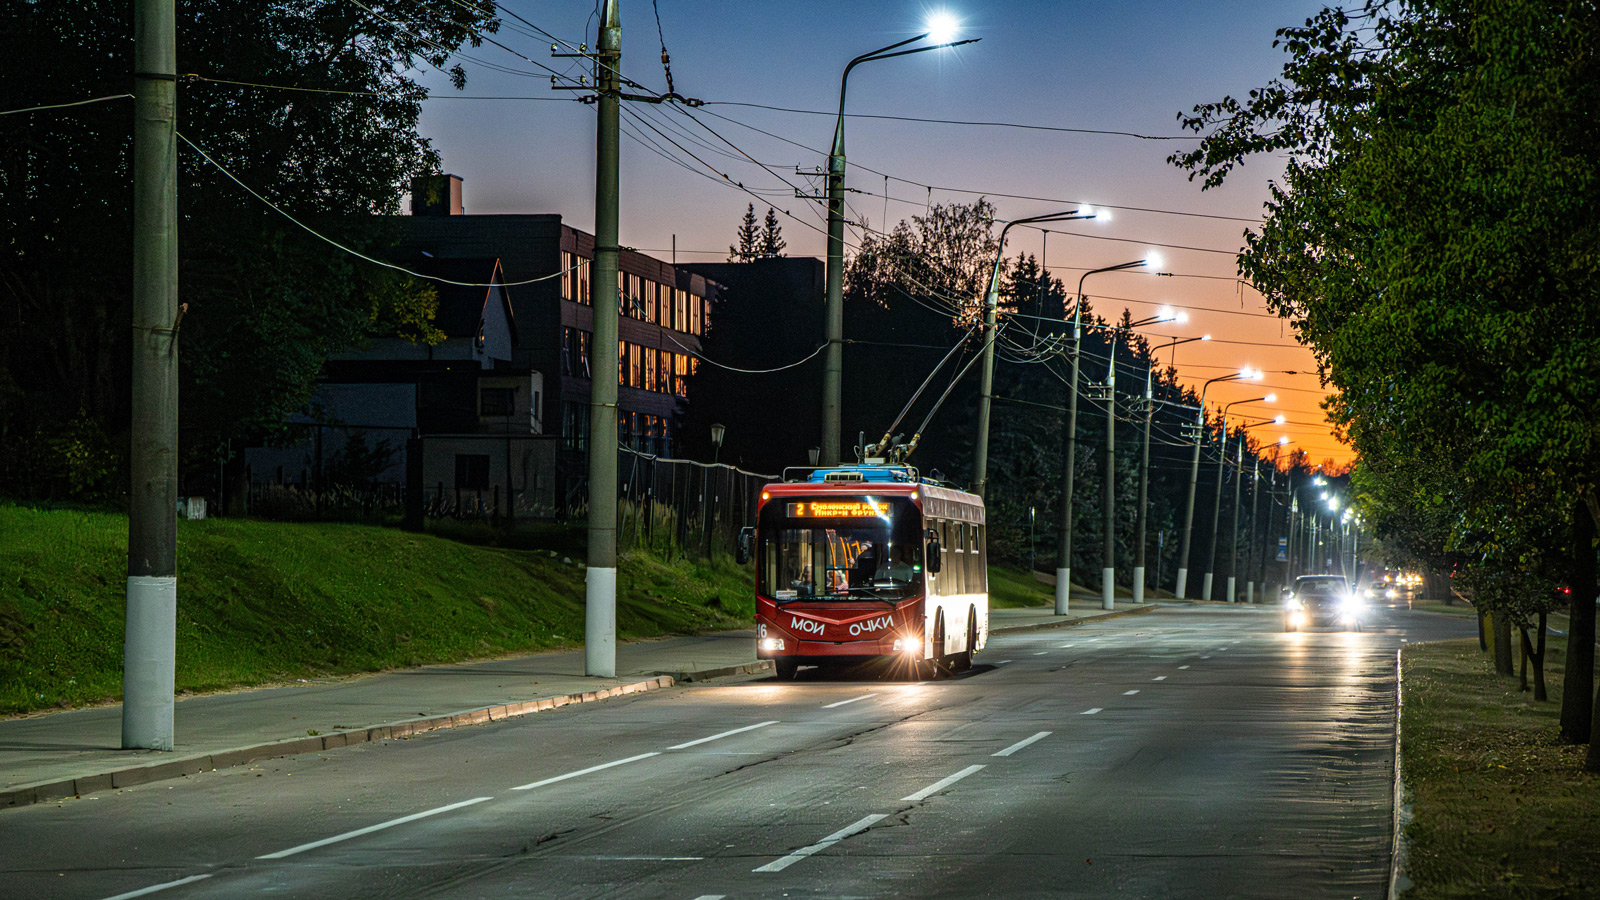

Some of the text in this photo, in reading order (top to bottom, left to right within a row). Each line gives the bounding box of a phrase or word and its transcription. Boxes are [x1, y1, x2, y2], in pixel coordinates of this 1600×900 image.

[796, 502, 805, 516] 2
[791, 615, 894, 636] МОИ ОЧКИ
